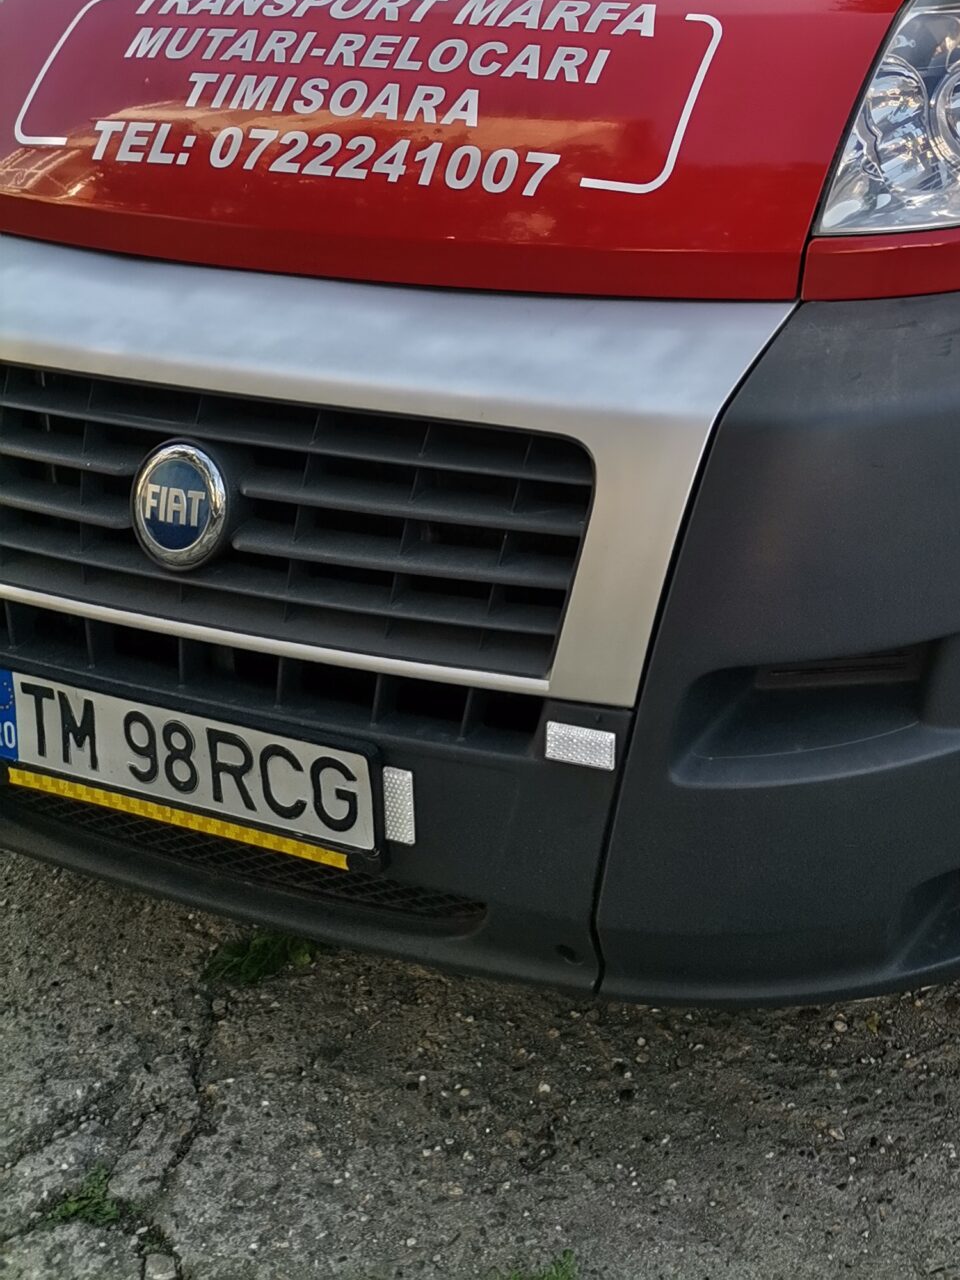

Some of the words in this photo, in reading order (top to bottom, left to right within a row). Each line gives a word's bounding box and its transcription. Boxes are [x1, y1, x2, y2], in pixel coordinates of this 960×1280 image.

[124, 27, 610, 84] MUTARI-RELOCARI
[185, 73, 481, 128] TIMISOARA
[92, 121, 196, 167] TEL:
[209, 126, 560, 197] 0722241007
[144, 483, 206, 528] FIAT
[20, 681, 99, 772] TM
